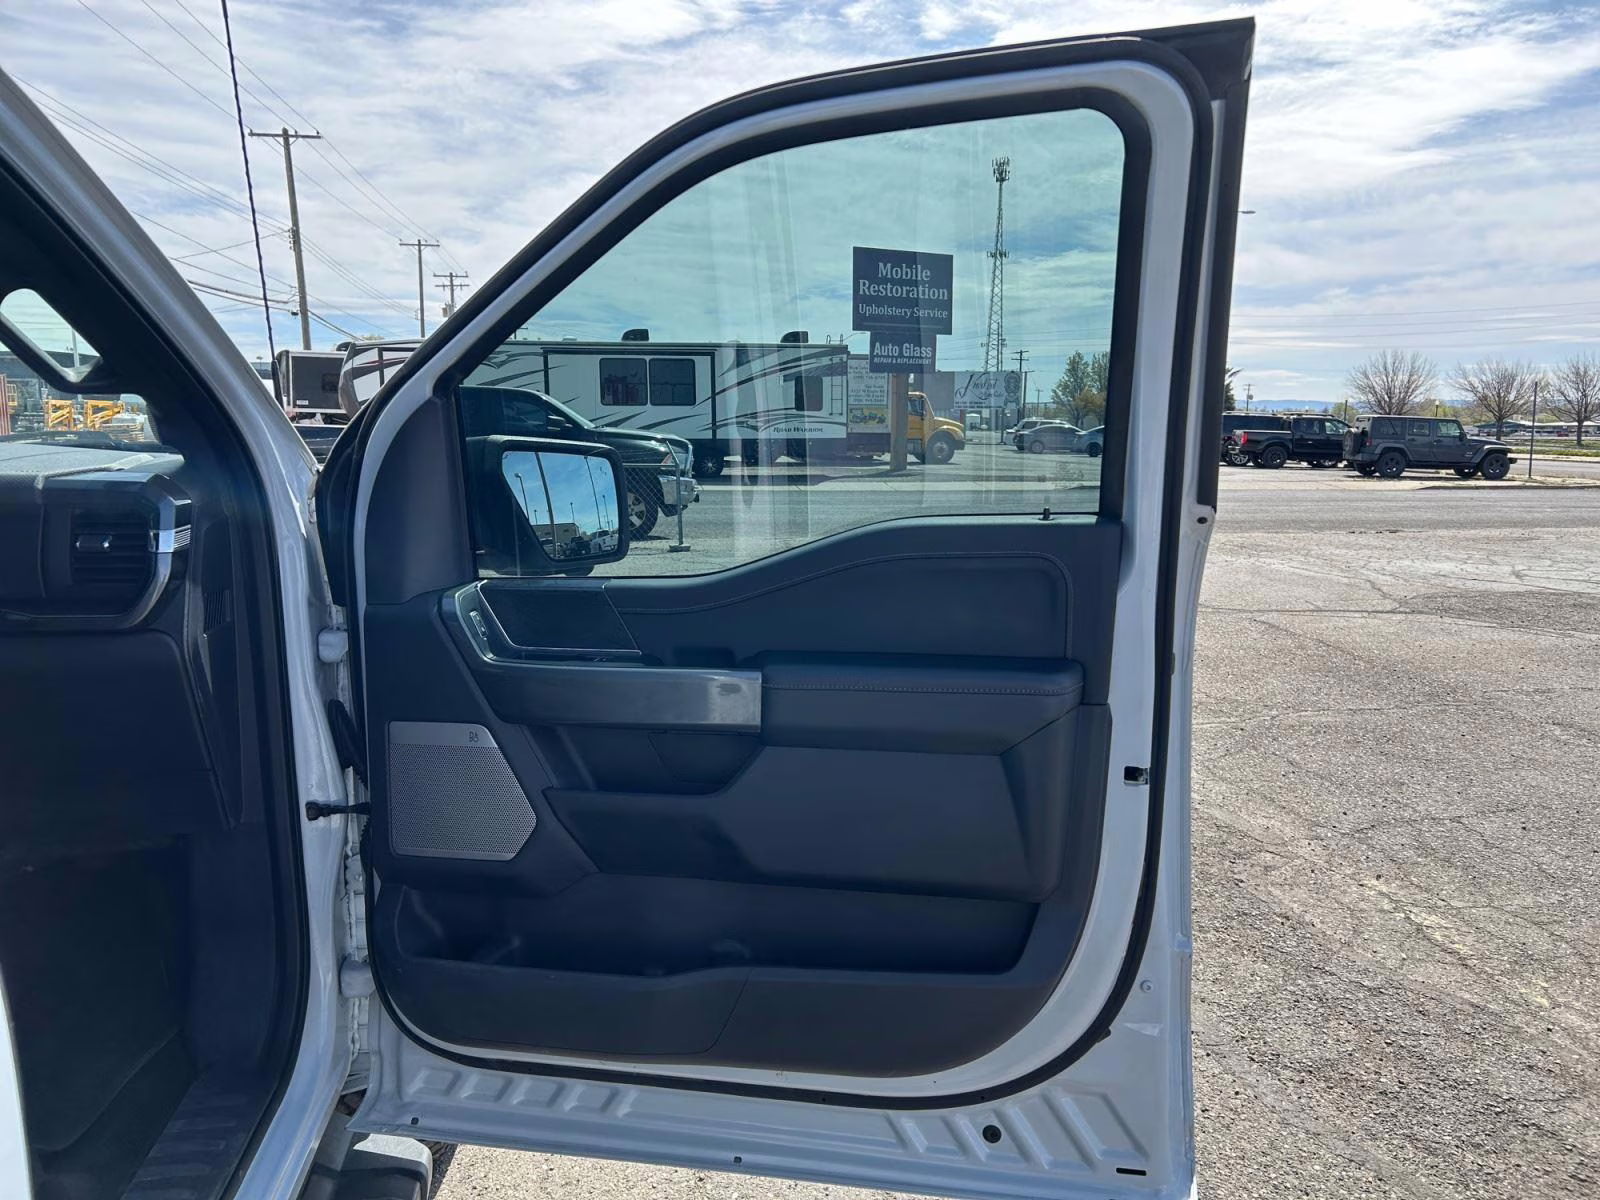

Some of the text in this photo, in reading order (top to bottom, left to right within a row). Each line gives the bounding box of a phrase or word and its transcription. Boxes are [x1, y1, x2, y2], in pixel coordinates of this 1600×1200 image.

[878, 262, 931, 281] Mobile
[858, 279, 948, 300] Restoration
[858, 303, 948, 319] Upholstery Service
[873, 341, 932, 358] Auto Glass
